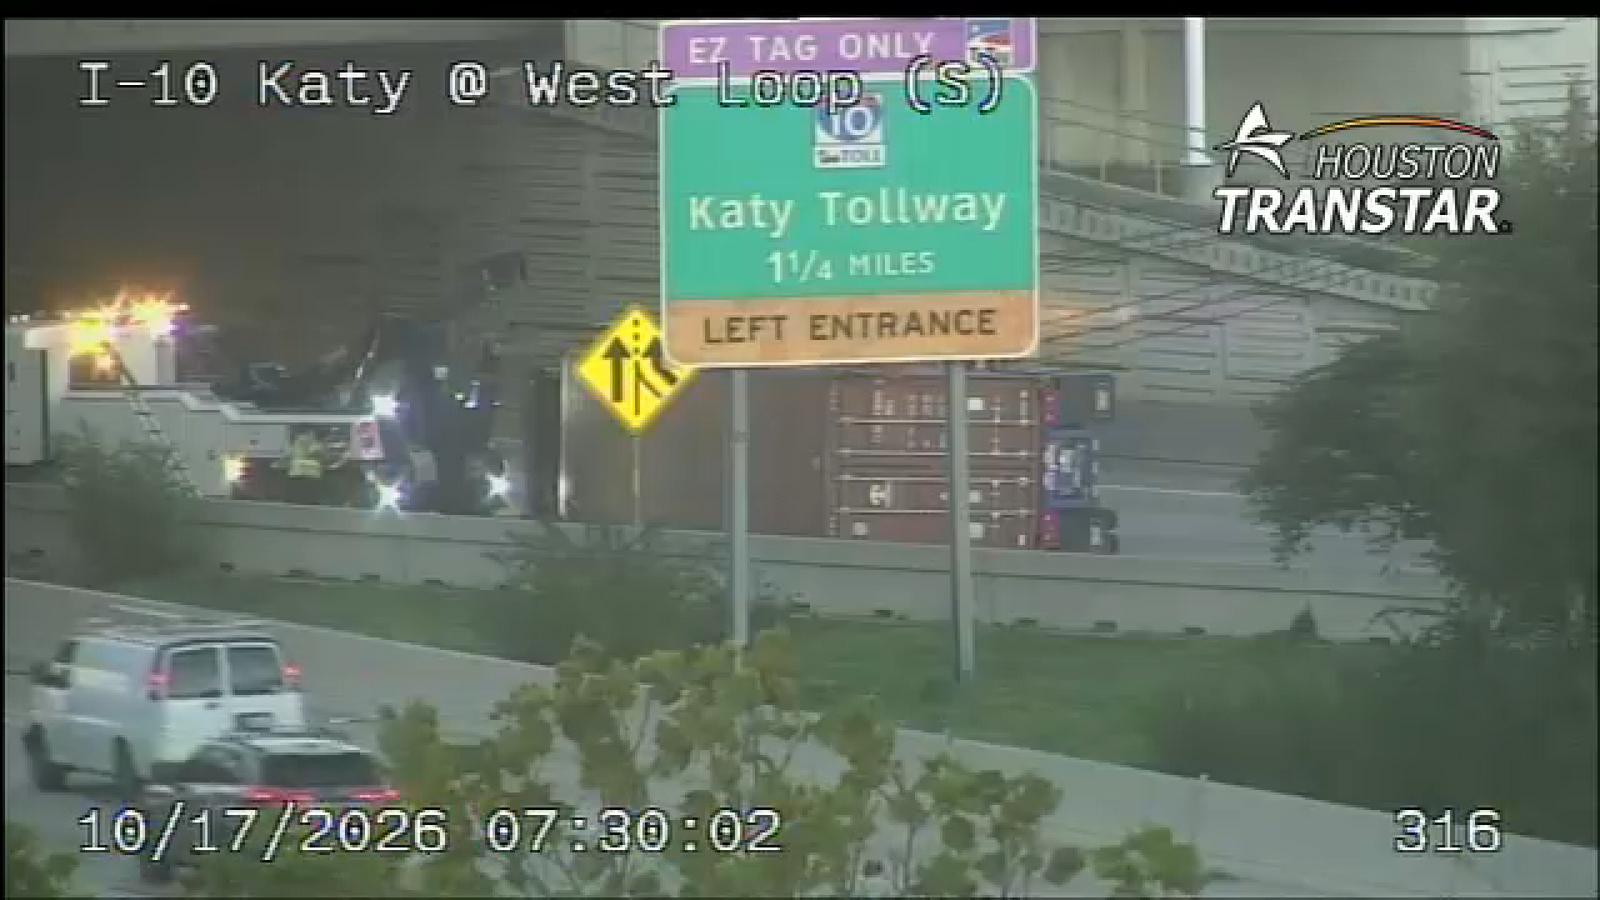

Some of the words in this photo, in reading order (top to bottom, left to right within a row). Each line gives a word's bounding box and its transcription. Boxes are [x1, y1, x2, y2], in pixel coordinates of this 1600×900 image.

[689, 37, 727, 63] EZ
[750, 34, 818, 62] TAG
[839, 32, 936, 60] ONLY
[689, 195, 795, 238] Katy
[819, 187, 1006, 231] Tollway
[849, 252, 936, 277] MILES
[704, 314, 788, 344] LEFT
[809, 309, 998, 341] ENTRANCE
